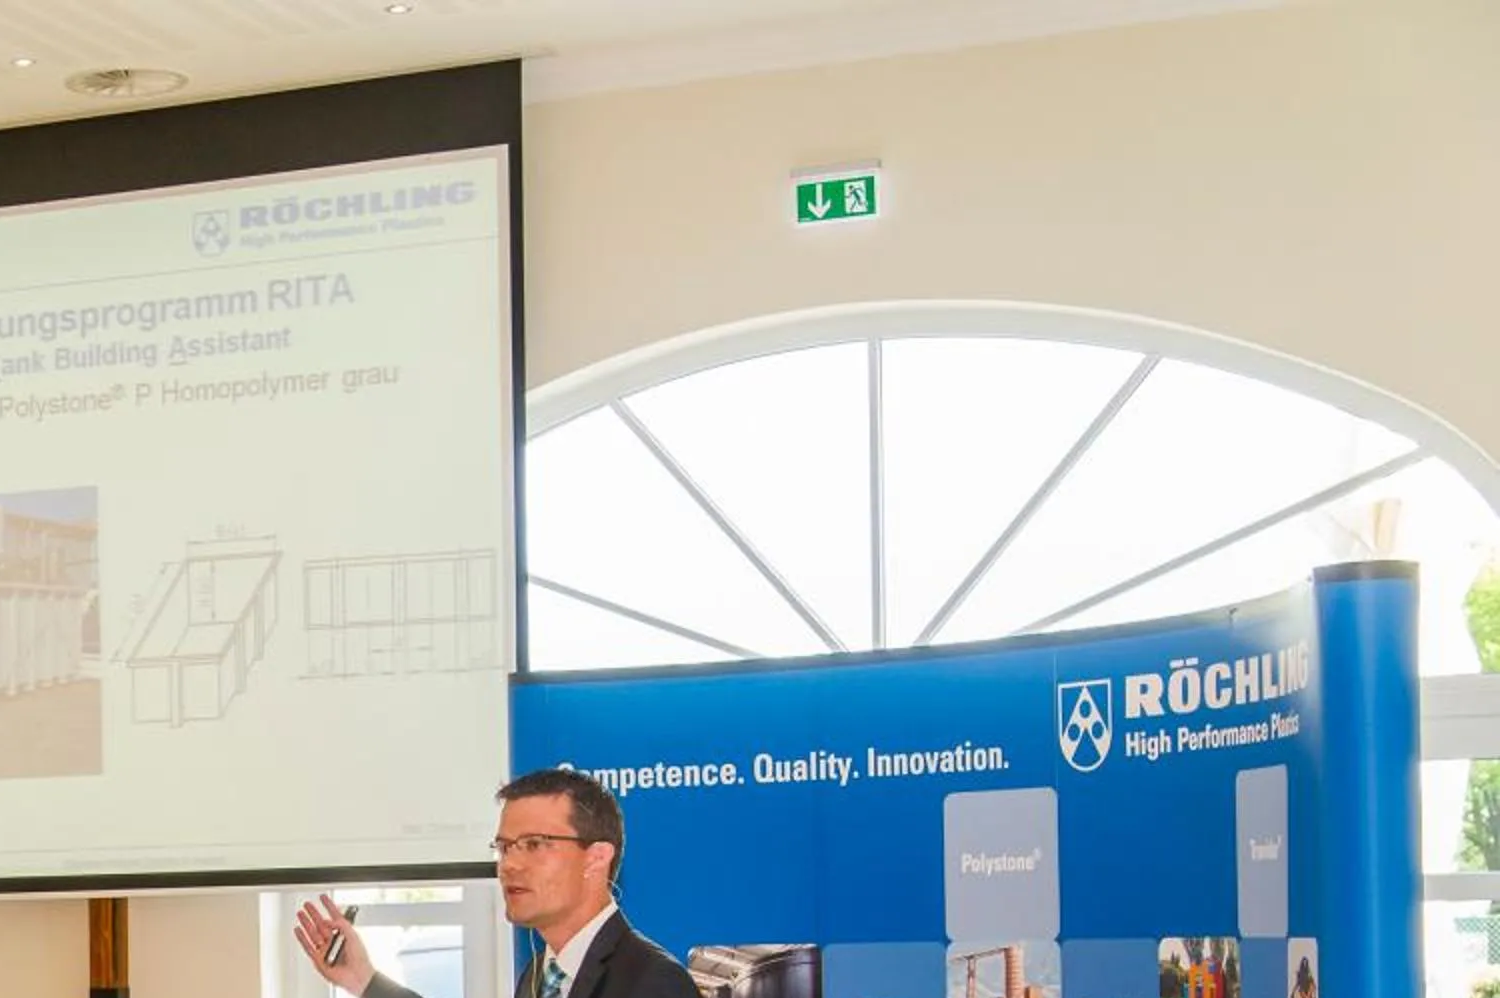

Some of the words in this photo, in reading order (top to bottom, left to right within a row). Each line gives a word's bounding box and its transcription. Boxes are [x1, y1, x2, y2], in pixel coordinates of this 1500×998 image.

[240, 181, 476, 229] RÖCHLING
[267, 273, 355, 311] RITA
[55, 341, 158, 370] Building
[169, 328, 292, 362] Assistant
[135, 383, 152, 406] P
[162, 371, 330, 406] Homopolymer
[341, 366, 400, 393] grau
[1124, 642, 1309, 719] RÖCHLING
[1125, 730, 1171, 761] High
[1177, 721, 1268, 752] Performance
[557, 763, 744, 796] mpetence.
[753, 751, 859, 786] Quality.
[868, 741, 1009, 777] Innovation.
